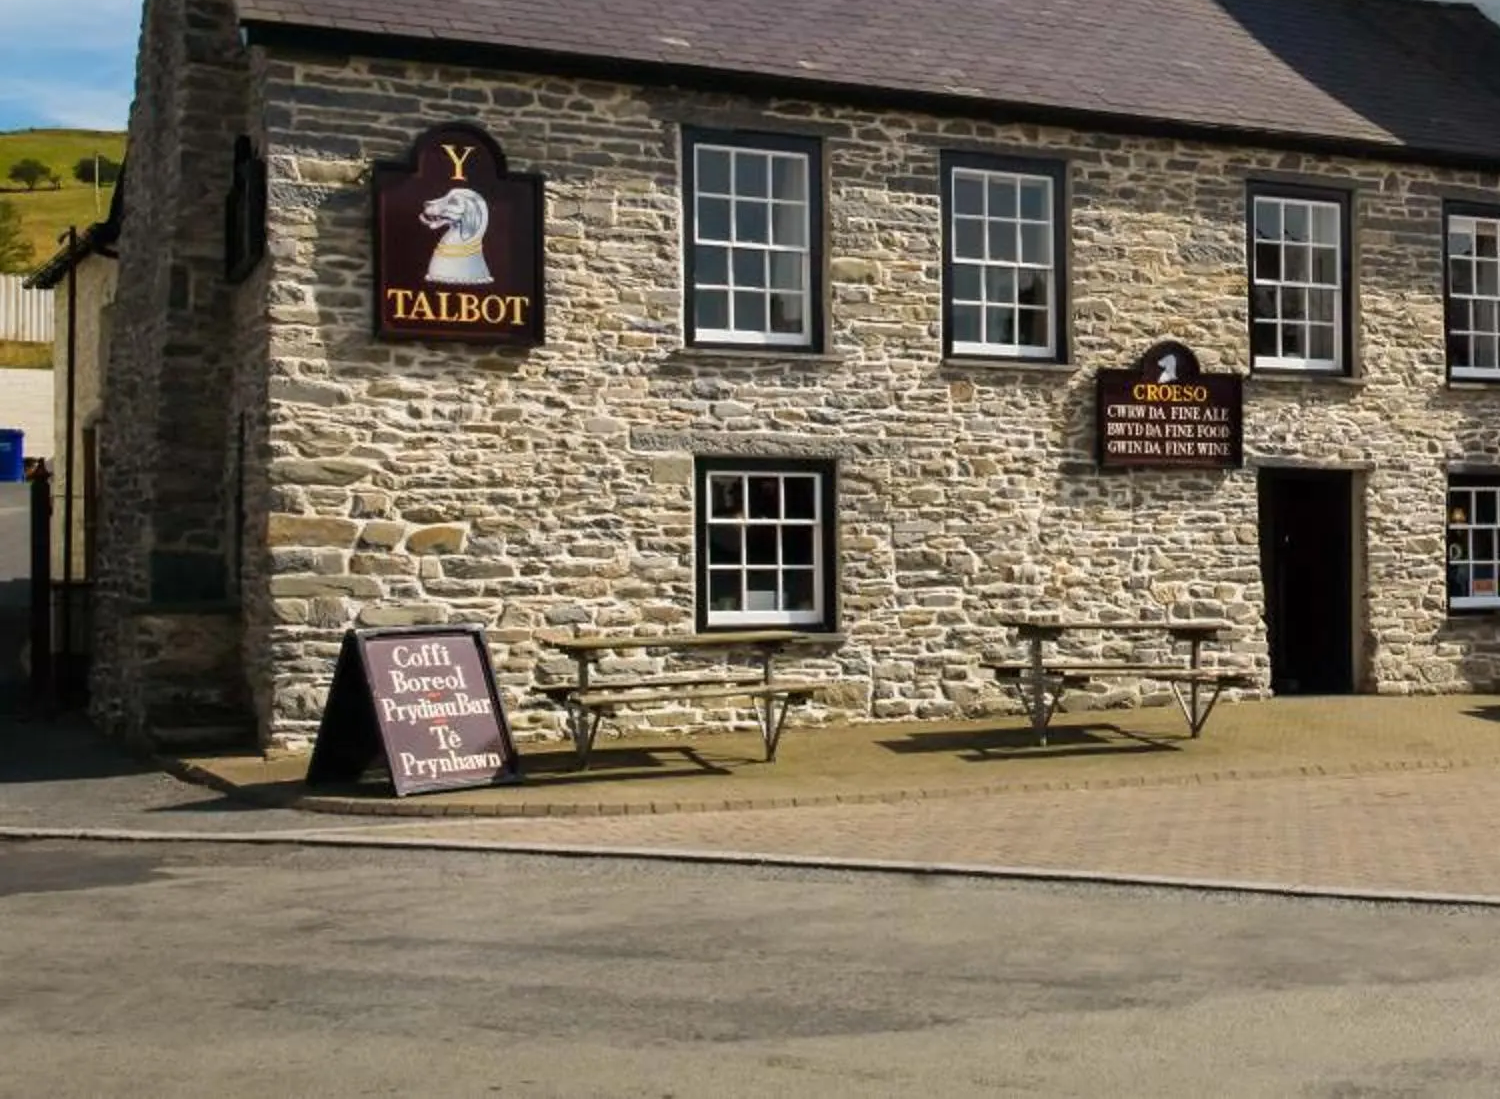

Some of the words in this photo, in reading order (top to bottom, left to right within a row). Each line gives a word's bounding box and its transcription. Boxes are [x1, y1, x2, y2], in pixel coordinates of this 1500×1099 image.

[440, 144, 477, 181] Y
[387, 288, 529, 326] TALBOT
[1133, 384, 1207, 401] CROESO
[1107, 404, 1146, 419] CWRW
[1149, 406, 1166, 420] DA
[1171, 406, 1200, 420] FINE
[1203, 407, 1229, 421] ALE
[1107, 422, 1144, 436] BWYD
[1145, 423, 1162, 437] DA
[1165, 424, 1195, 438] FINE
[1197, 424, 1231, 438] FOOD
[1107, 440, 1142, 454] GWIN
[1144, 441, 1161, 454] DA
[1165, 442, 1195, 456] FINE
[1197, 442, 1231, 456] WINE
[392, 642, 452, 668] Coffi
[388, 664, 468, 694] Boreol
[400, 750, 502, 778] Prynhawn
